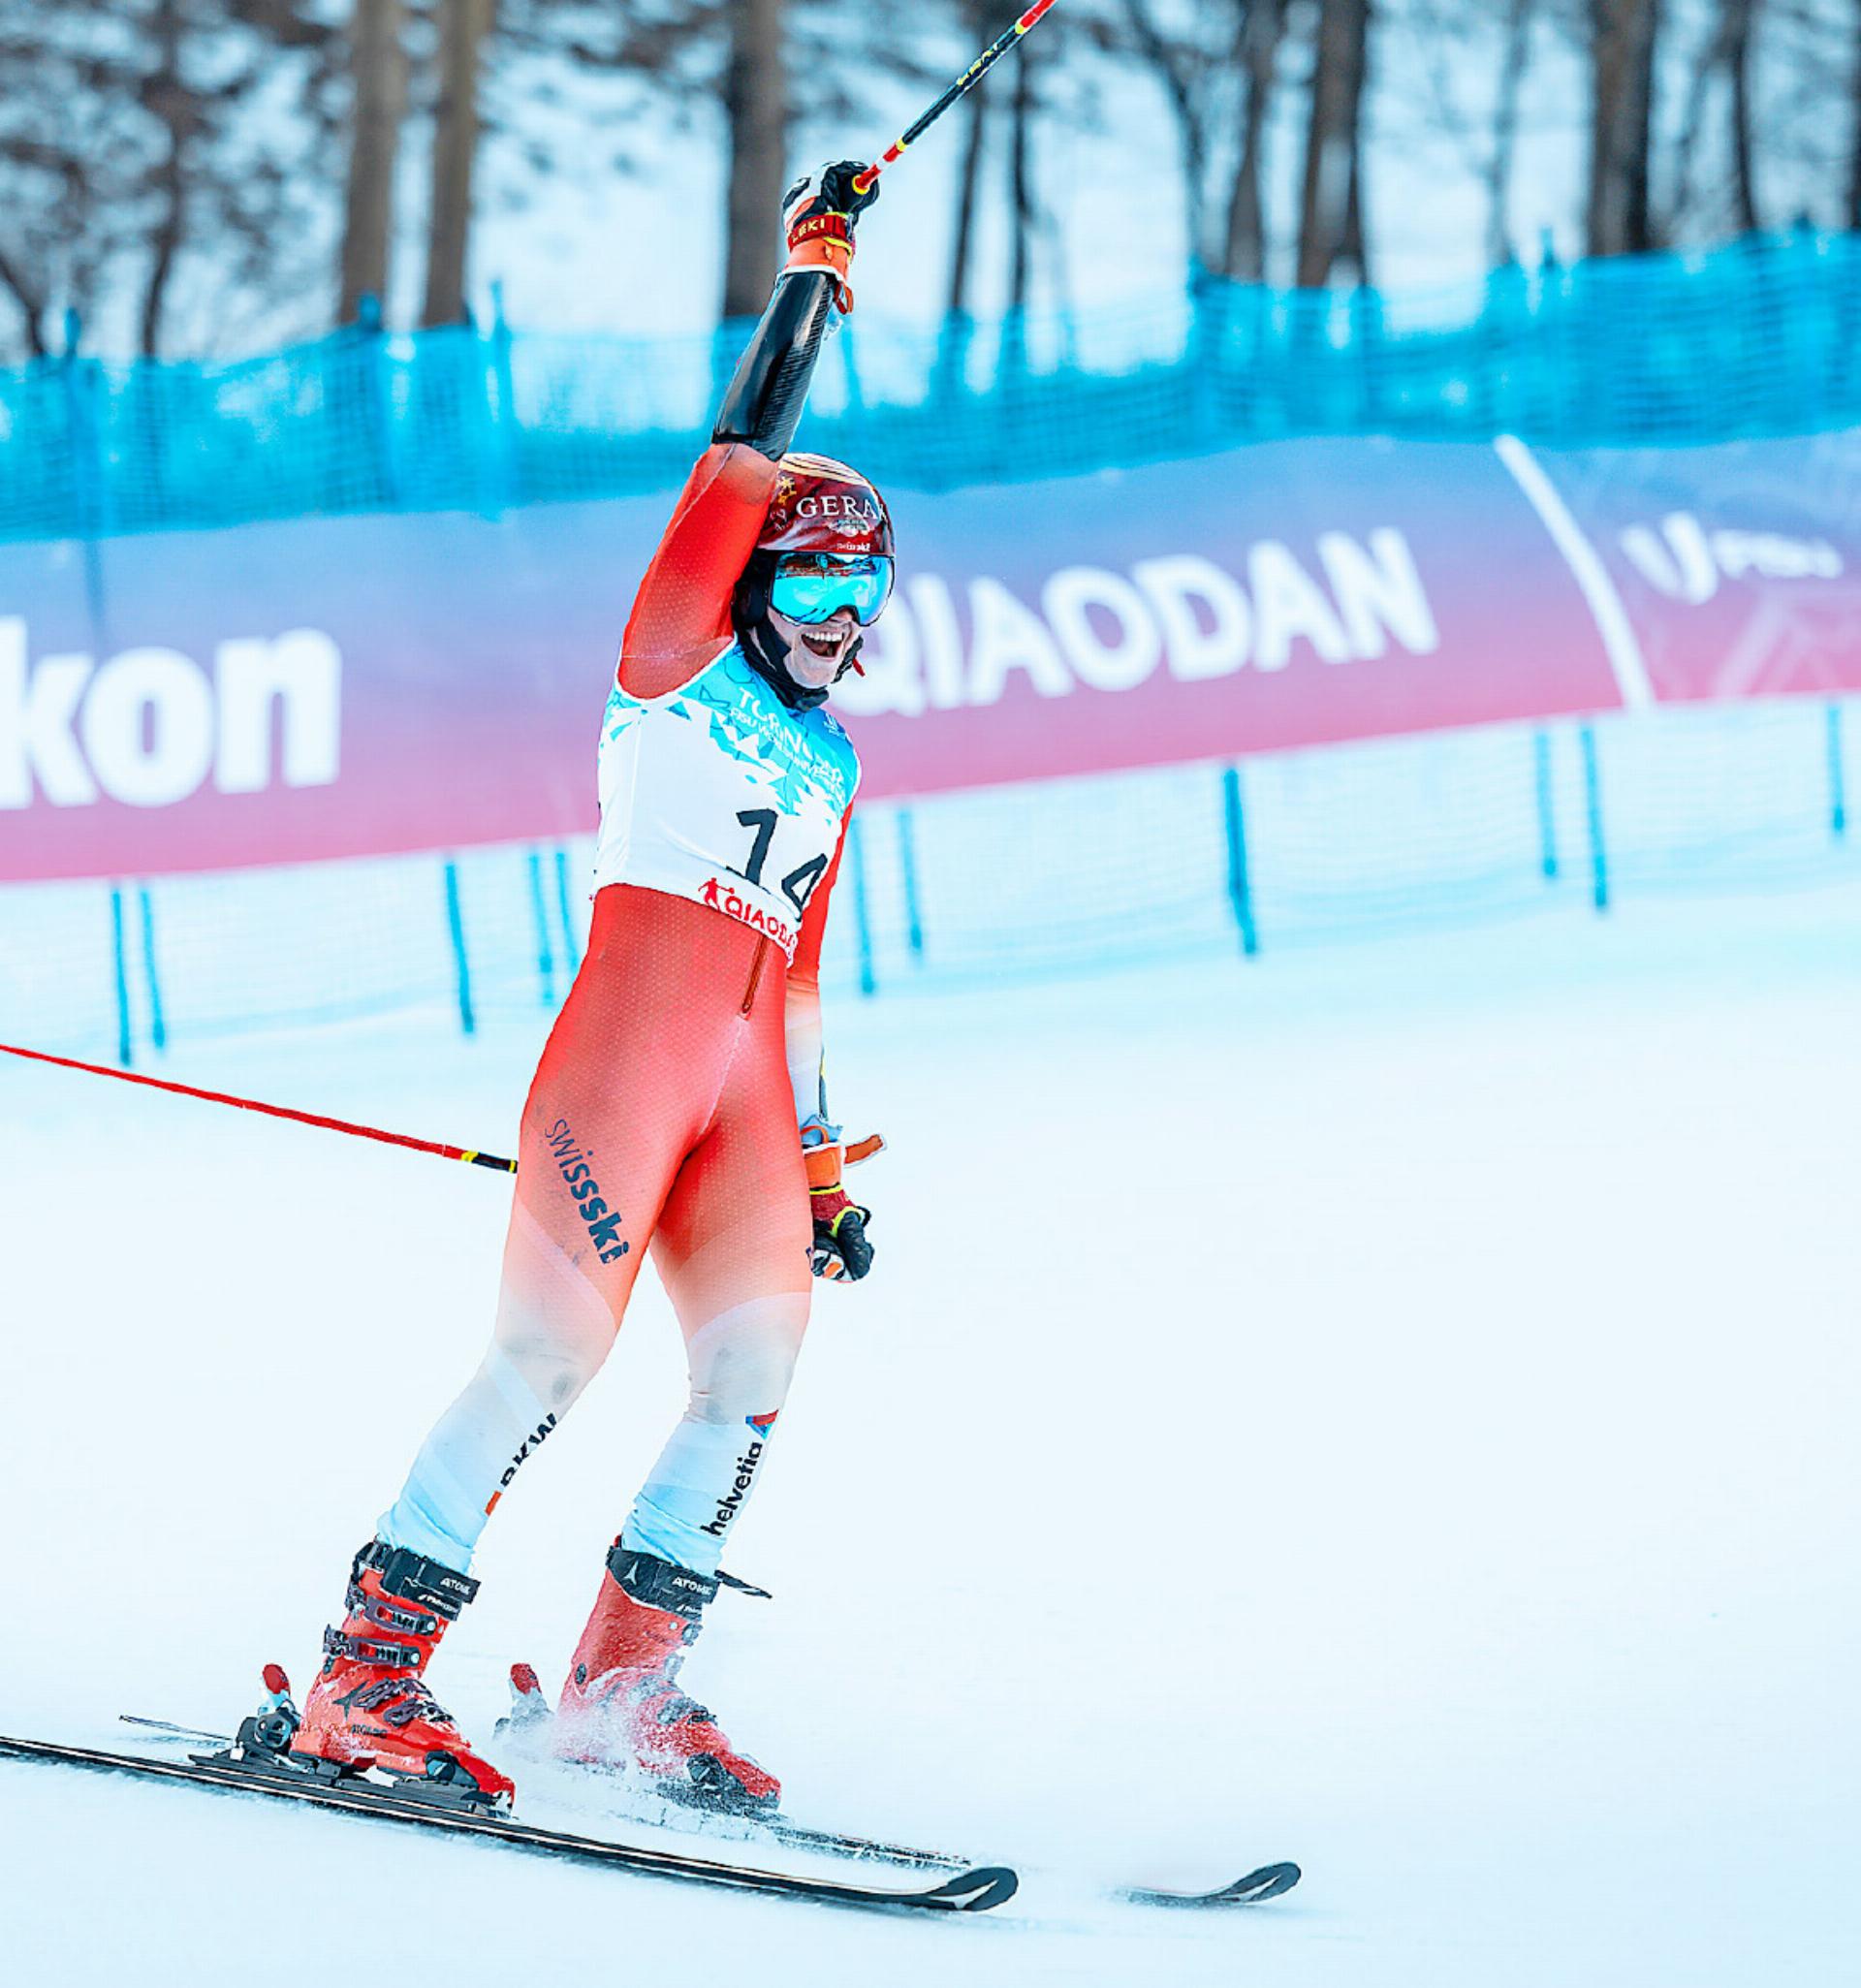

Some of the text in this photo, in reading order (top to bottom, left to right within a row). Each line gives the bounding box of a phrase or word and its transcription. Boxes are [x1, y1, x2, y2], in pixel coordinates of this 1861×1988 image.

[0, 614, 343, 811] kon
[836, 524, 1440, 718] QIAODAN
[700, 1441, 763, 1536] helvetia
